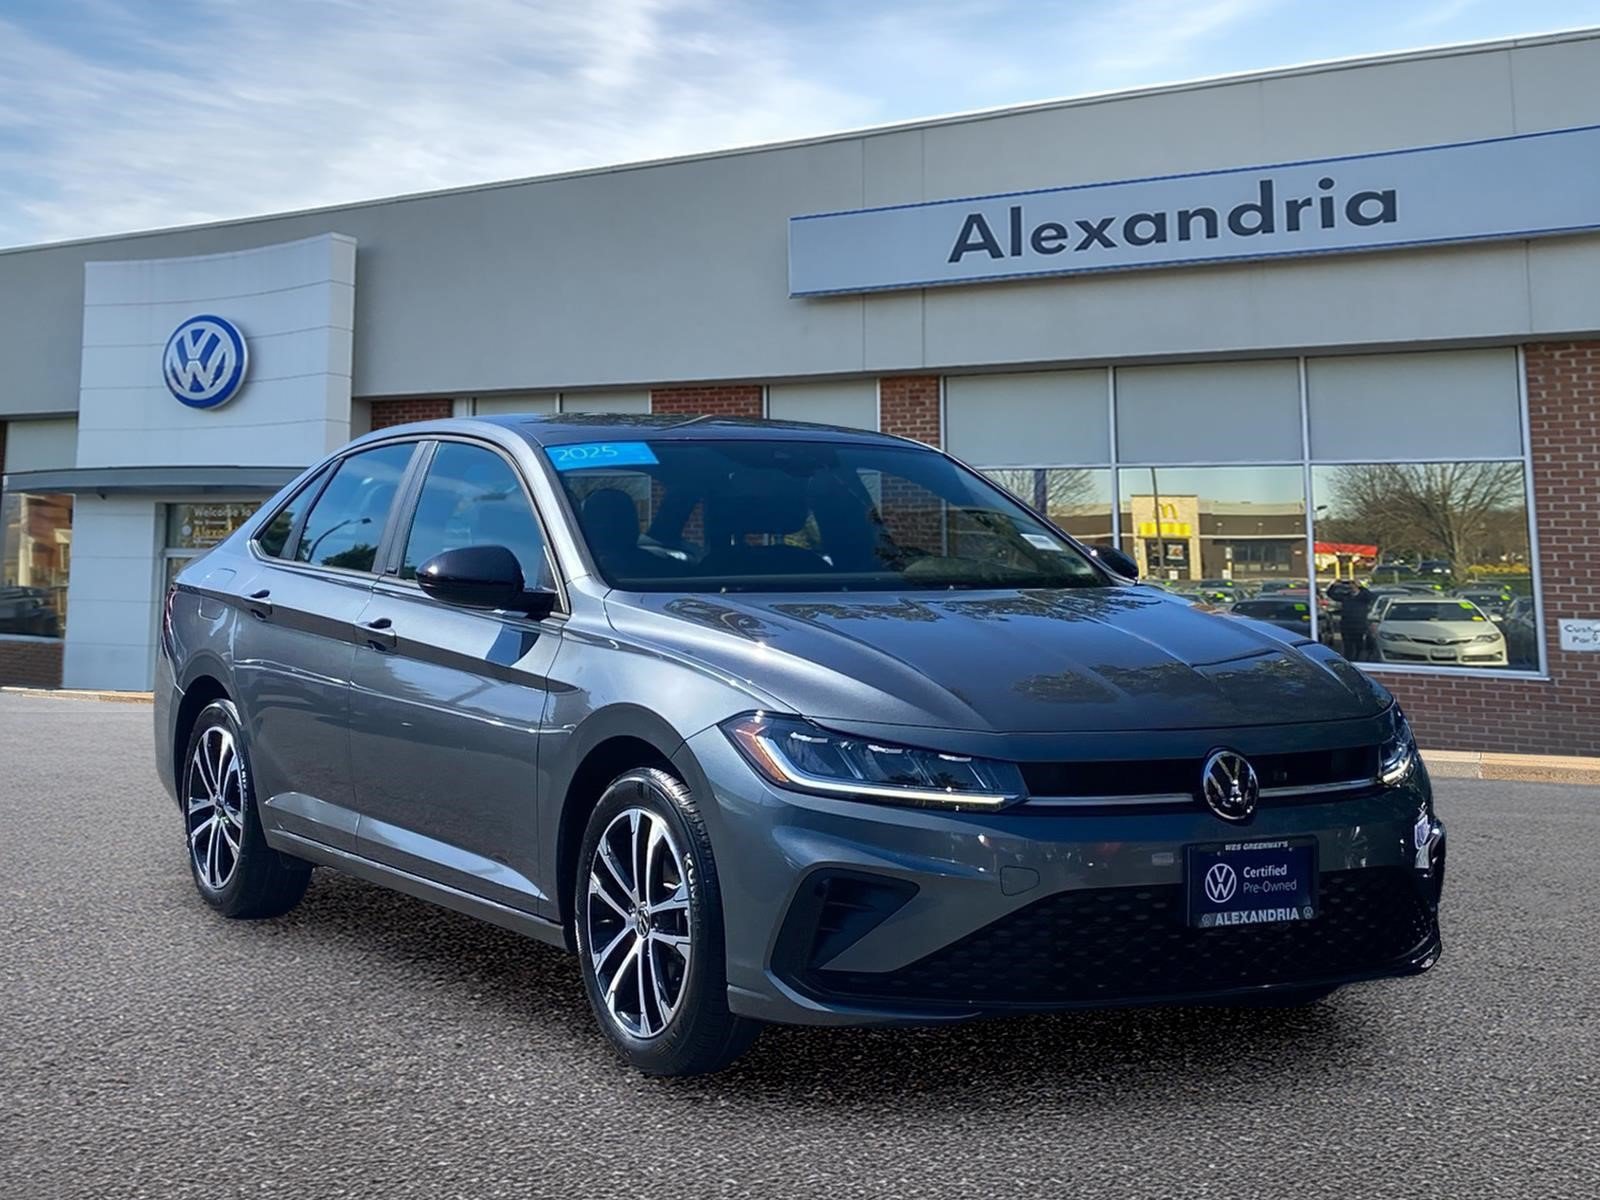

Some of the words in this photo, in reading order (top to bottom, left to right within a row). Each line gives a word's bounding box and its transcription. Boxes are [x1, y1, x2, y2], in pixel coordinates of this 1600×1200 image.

[948, 178, 1397, 263] Alexandria
[554, 445, 618, 461] 2025
[1225, 843, 1242, 851] WES
[1243, 864, 1288, 879] Certified
[1243, 880, 1297, 893] Pre-Owned
[1215, 908, 1300, 926] ALEXANDRIA
